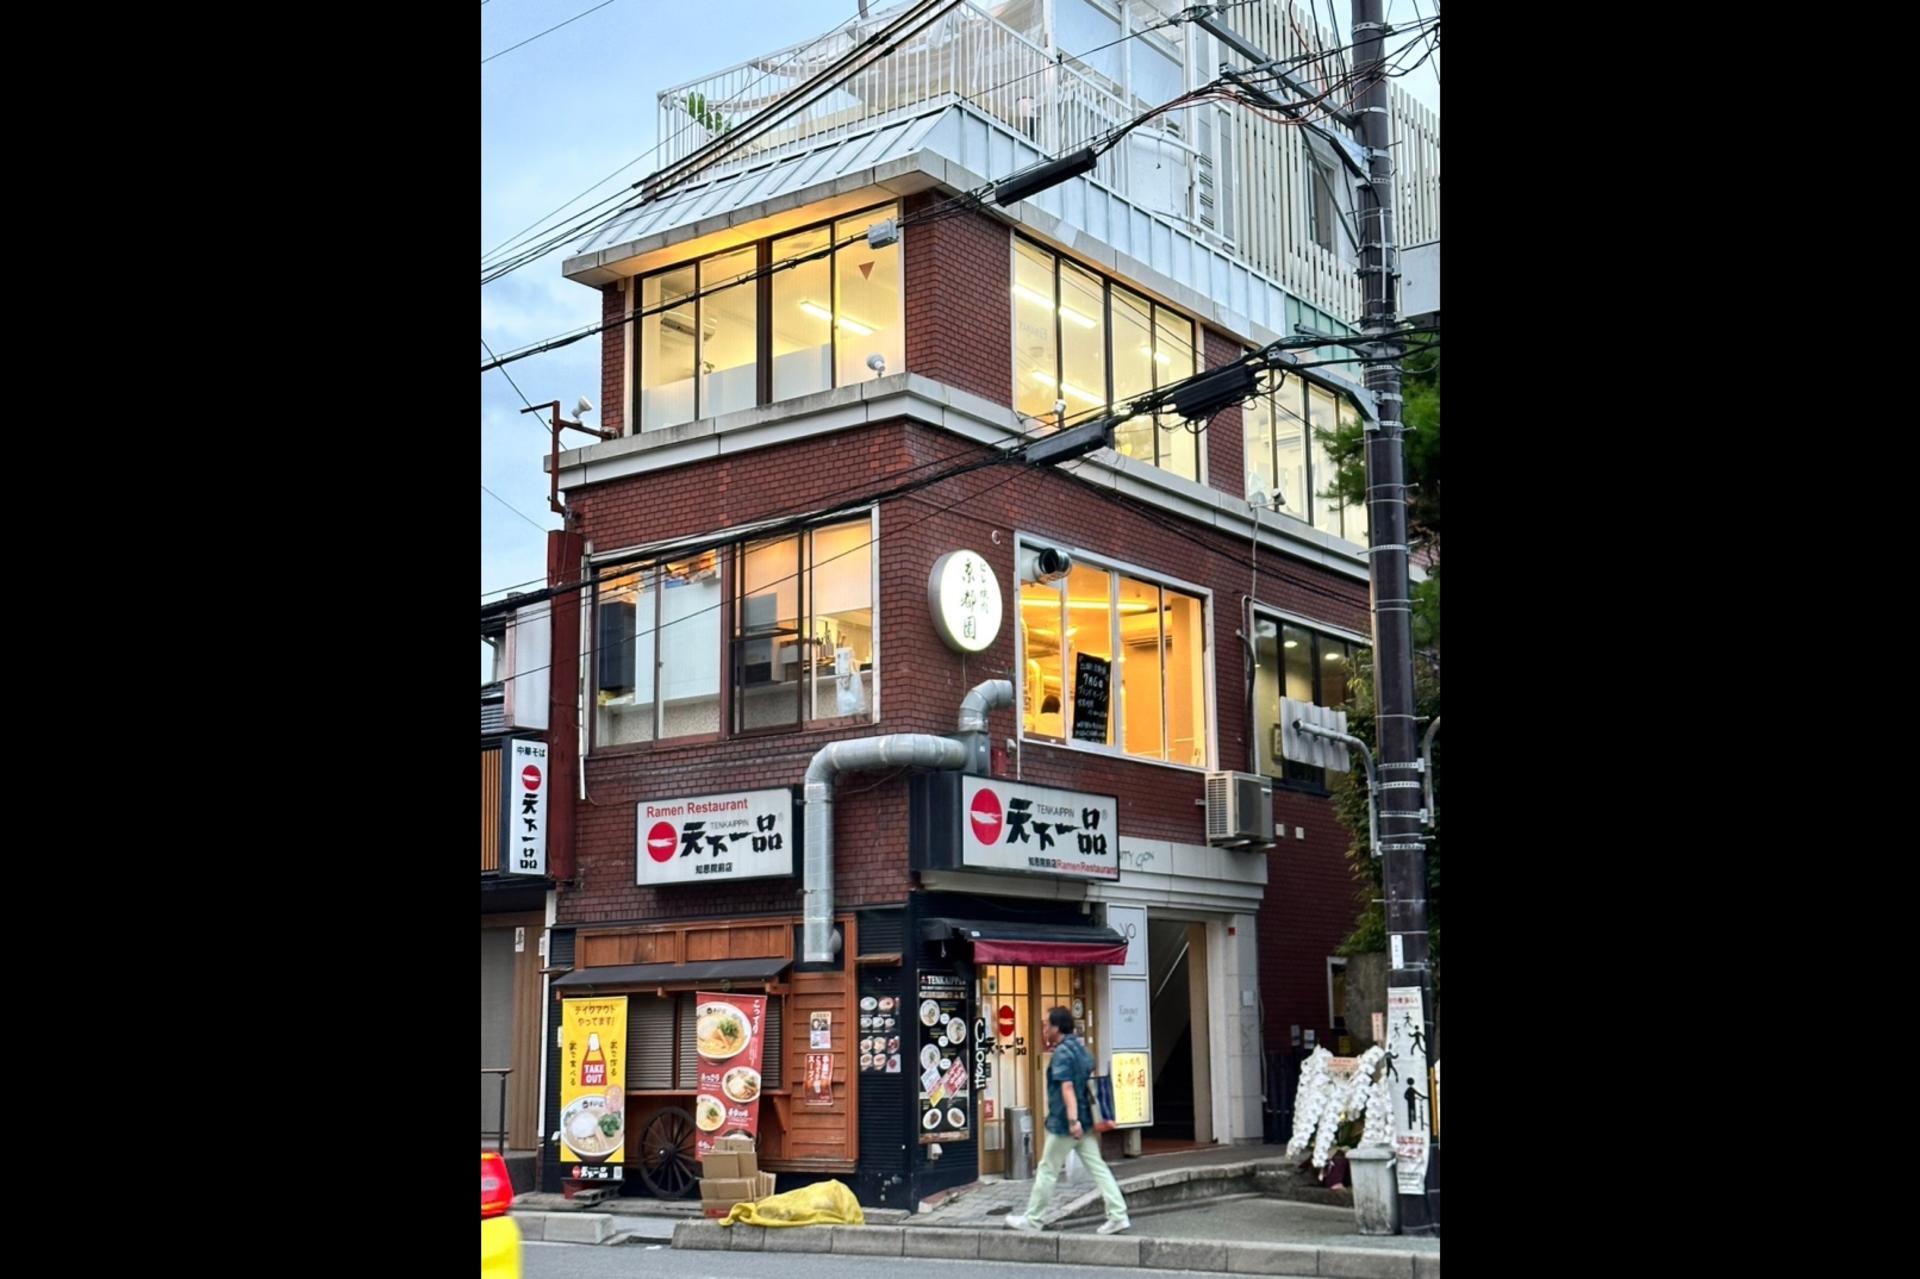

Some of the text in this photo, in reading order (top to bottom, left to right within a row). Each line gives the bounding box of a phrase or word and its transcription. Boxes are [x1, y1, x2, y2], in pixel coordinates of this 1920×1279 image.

[517, 746, 545, 758] 中華そば
[646, 798, 748, 818] Ramen Restaurant
[1037, 803, 1075, 818] TENKAIPPIN
[520, 792, 539, 869] 天下一品
[1006, 797, 1107, 856] 天下一品
[680, 813, 783, 858] 天下一品
[1056, 861, 1080, 872] Ramen
[575, 1004, 616, 1015] テイクアウト
[584, 1064, 604, 1074] TAKE
[585, 1074, 603, 1084] OUT
